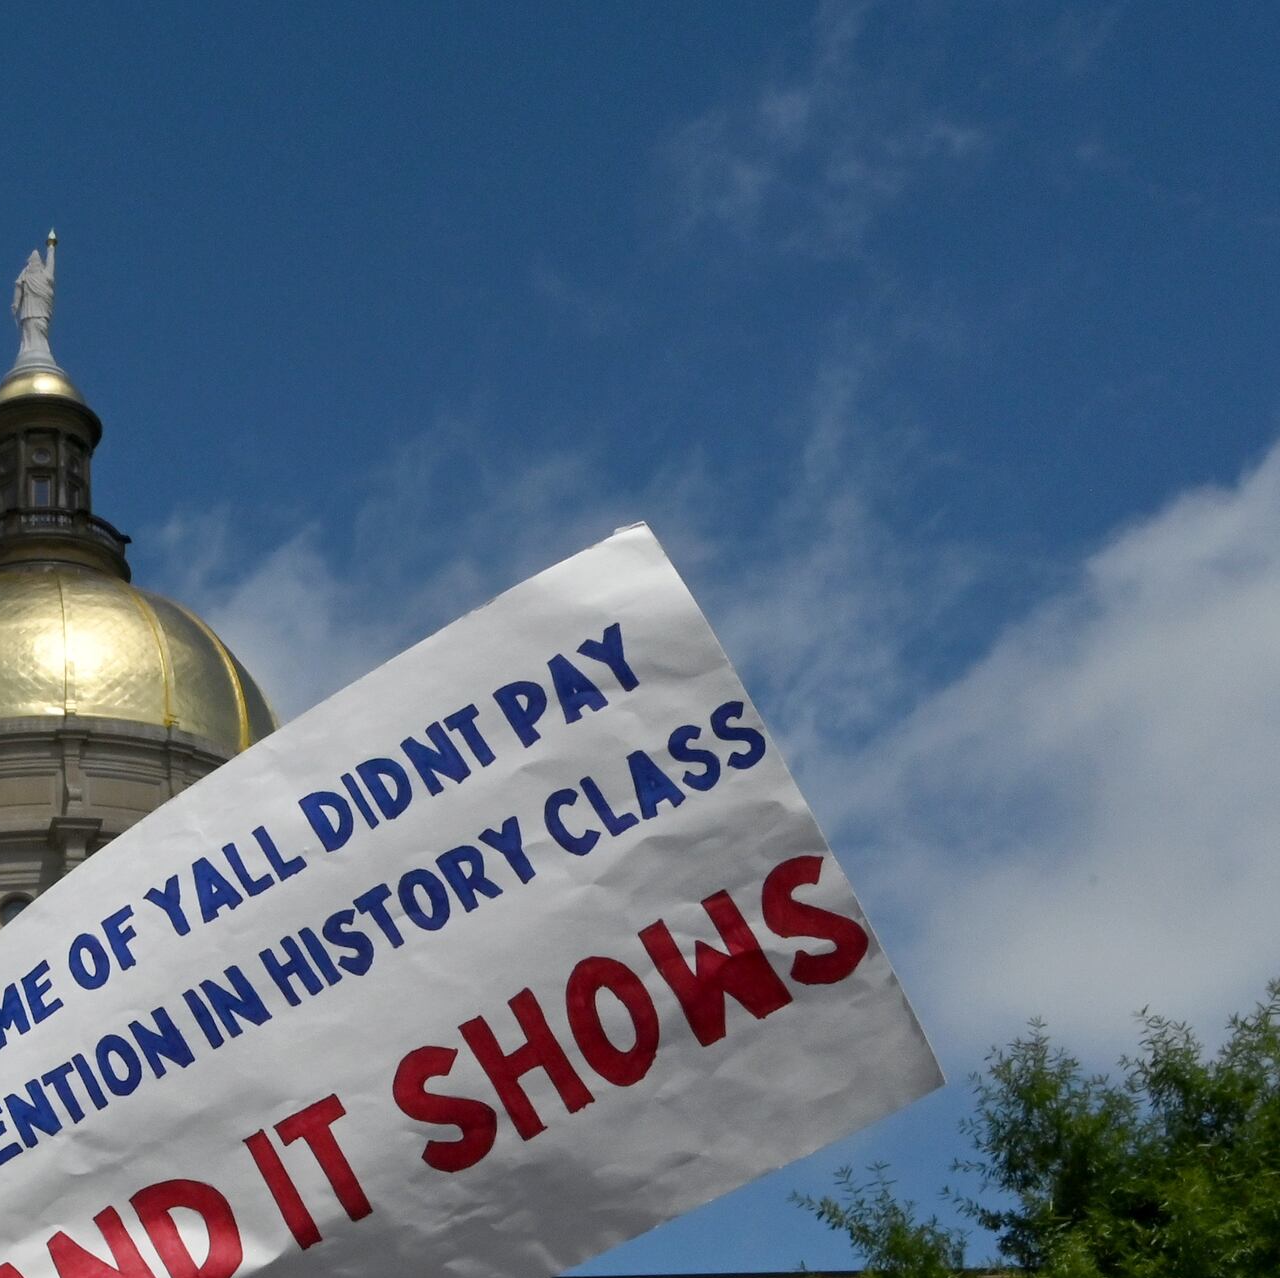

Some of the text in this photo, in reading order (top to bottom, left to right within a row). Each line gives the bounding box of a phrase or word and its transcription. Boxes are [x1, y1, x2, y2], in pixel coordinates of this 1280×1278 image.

[69, 905, 137, 991] OF
[145, 825, 307, 937] YALL
[298, 704, 496, 854] DIDNT
[493, 622, 642, 748] PAY
[184, 965, 272, 1049] IN
[259, 818, 536, 1008] HISTORY
[543, 700, 767, 856] CLASS
[242, 1093, 373, 1251] IT
[392, 855, 869, 1173] SHOWS
